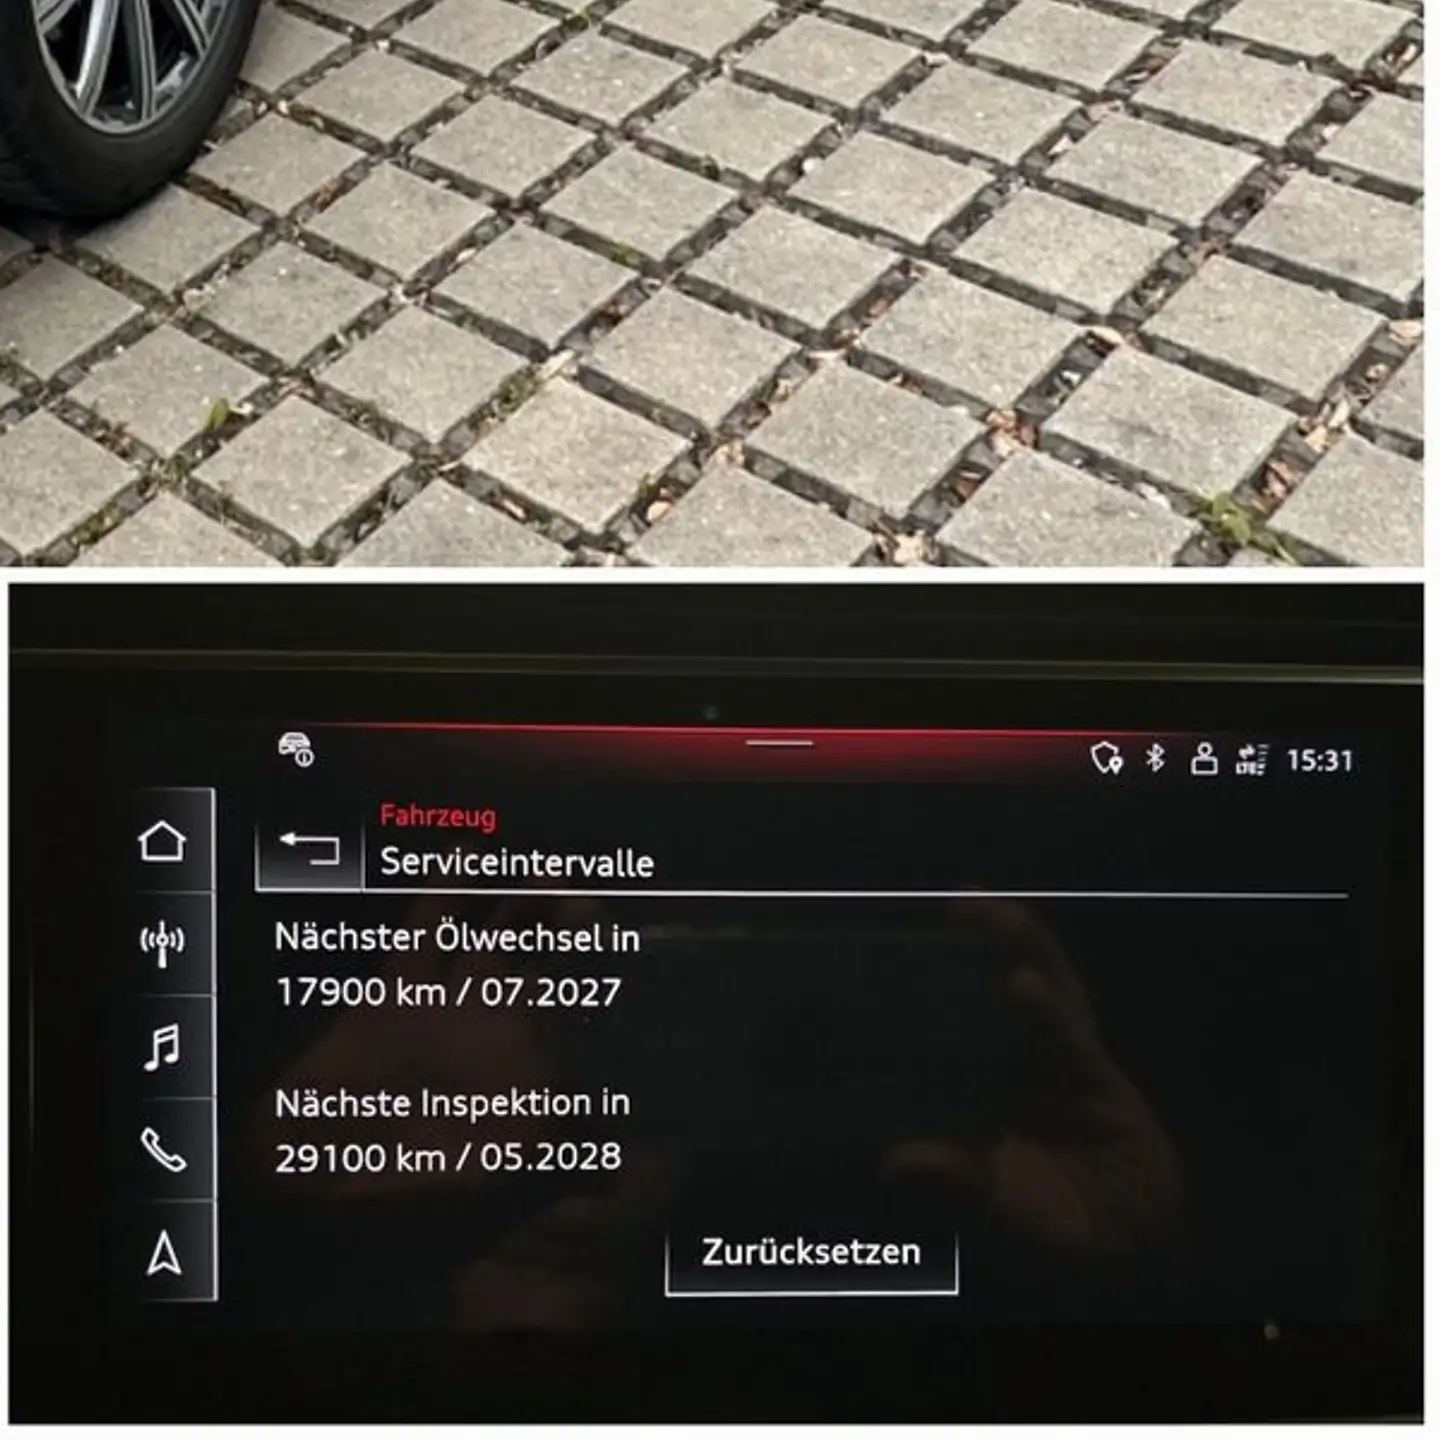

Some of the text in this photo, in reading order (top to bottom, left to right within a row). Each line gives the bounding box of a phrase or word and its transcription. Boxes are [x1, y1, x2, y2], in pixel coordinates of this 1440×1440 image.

[1287, 748, 1353, 772] 15:31
[381, 803, 497, 835] Fahrzeug
[380, 845, 655, 878] Serviceintervalle
[275, 915, 640, 952] Nächster Ölwechsel in
[277, 976, 622, 1007] 17900 km / 07.2027
[276, 1086, 630, 1124] Nächste Inspektion in
[275, 1141, 622, 1173] 29100 km / 05.2028
[702, 1236, 921, 1266] Zurücksetzen
